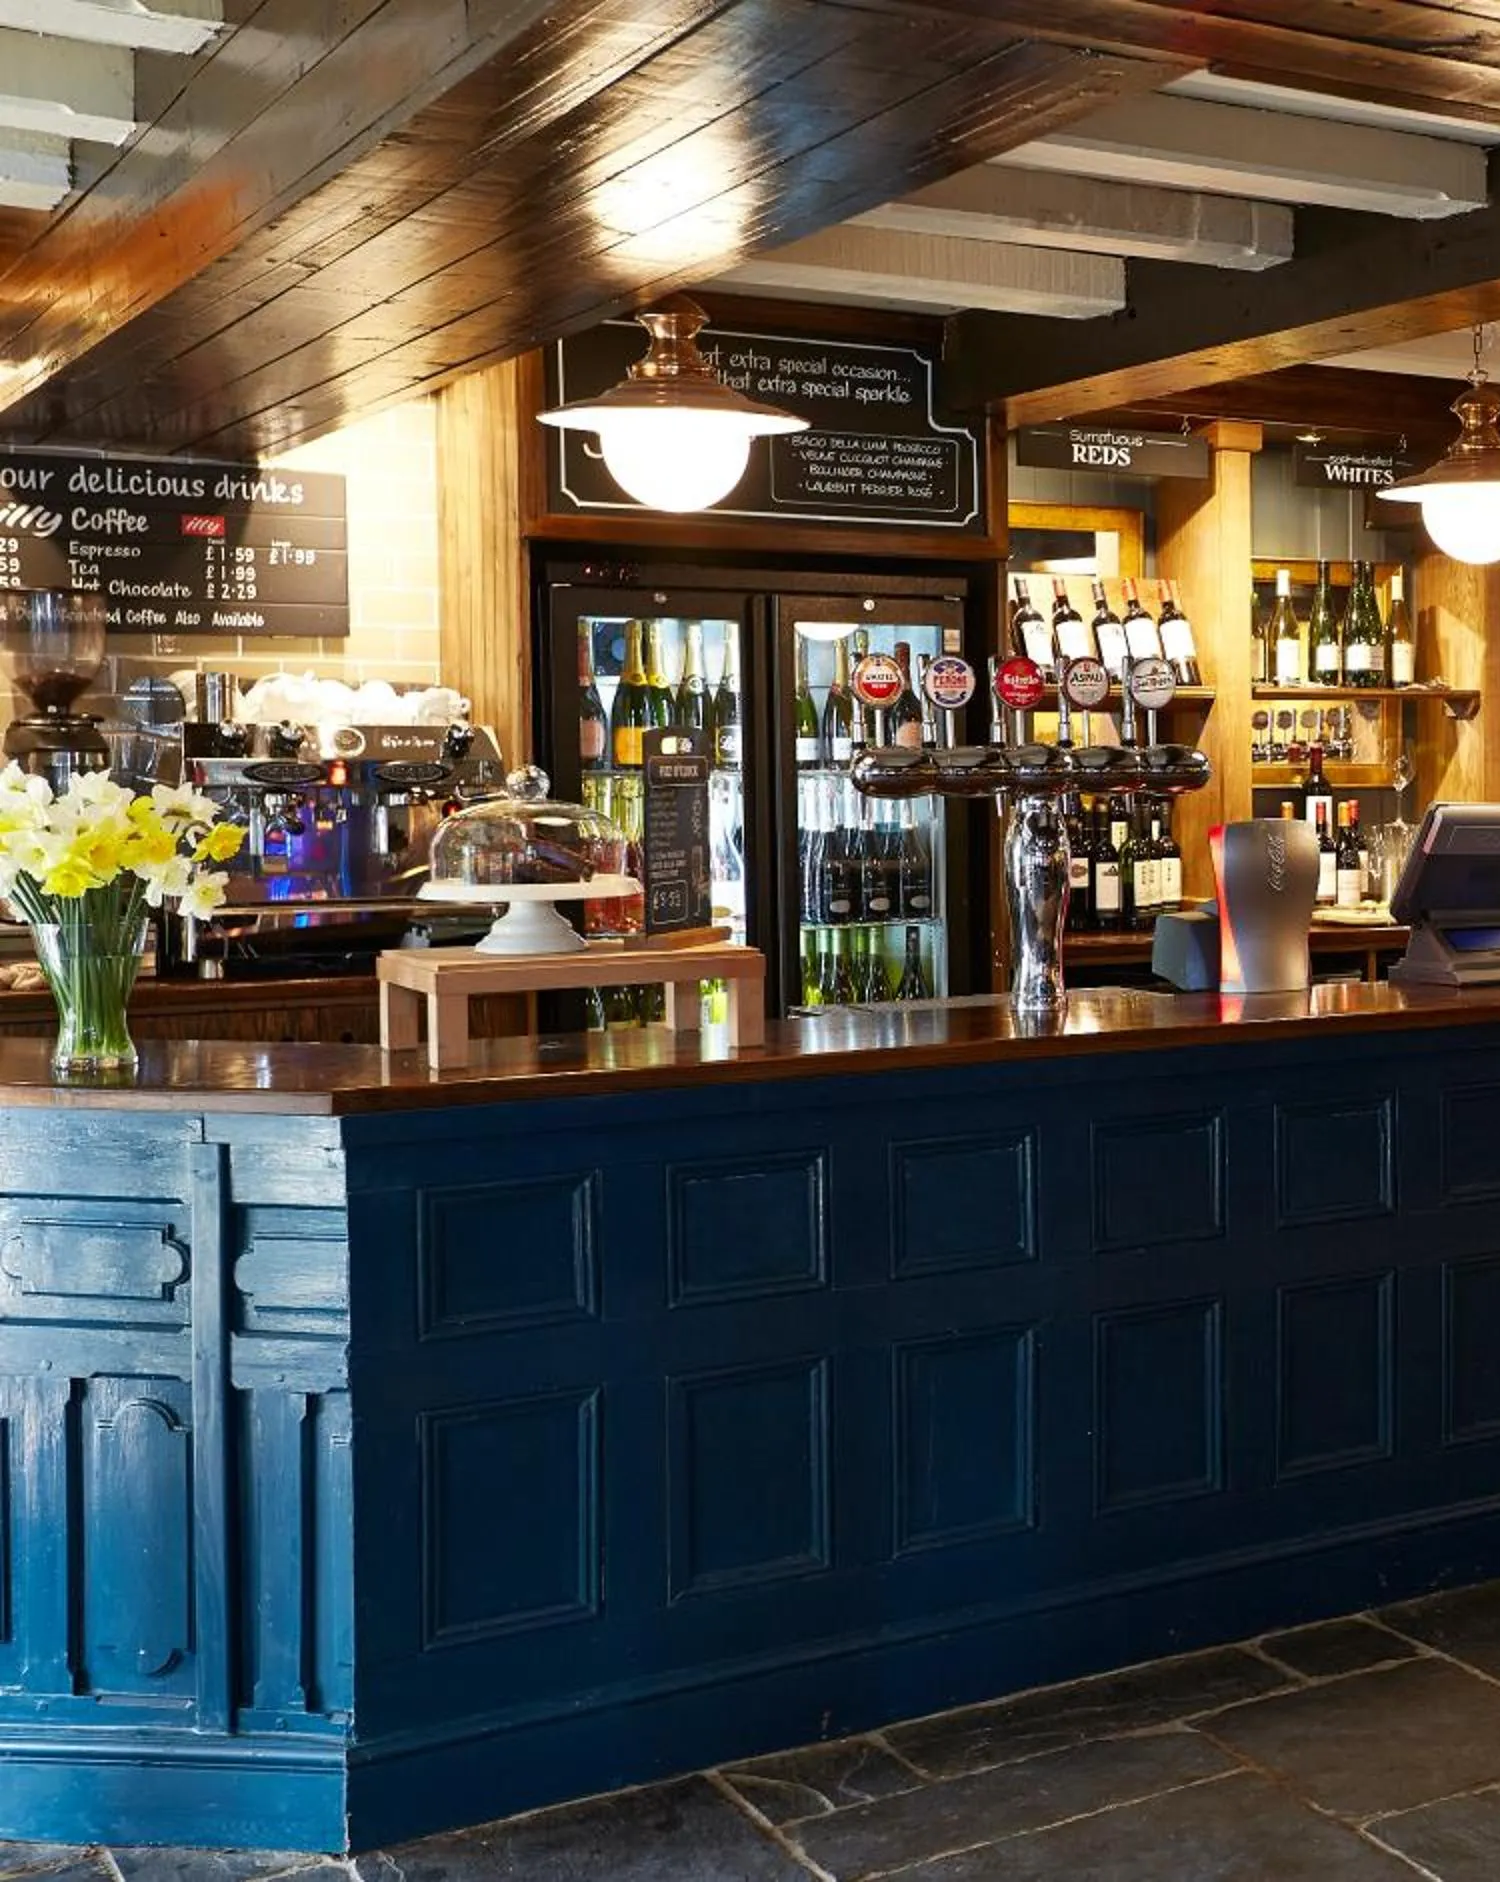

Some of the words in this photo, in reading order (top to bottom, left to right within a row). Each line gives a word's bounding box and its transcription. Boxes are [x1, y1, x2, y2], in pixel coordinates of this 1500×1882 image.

[729, 348, 772, 371] extra
[778, 357, 827, 375] special
[758, 374, 797, 394] extra
[801, 380, 849, 399] special
[855, 384, 912, 405] sparkle
[1069, 428, 1143, 447] Sumptuous
[1071, 443, 1131, 467] REDS
[0, 467, 54, 491] our
[68, 464, 205, 497] delicious
[214, 473, 304, 504] drinks
[1323, 463, 1394, 485] WHITES
[0, 502, 63, 537] illy
[71, 506, 150, 535] Coffee
[185, 517, 222, 535] illy
[69, 540, 141, 560] Espresso
[67, 559, 100, 575] Tea
[108, 580, 193, 598] Chocolate
[125, 609, 168, 626] Coffee
[174, 610, 201, 625] Also
[212, 611, 265, 627] Available
